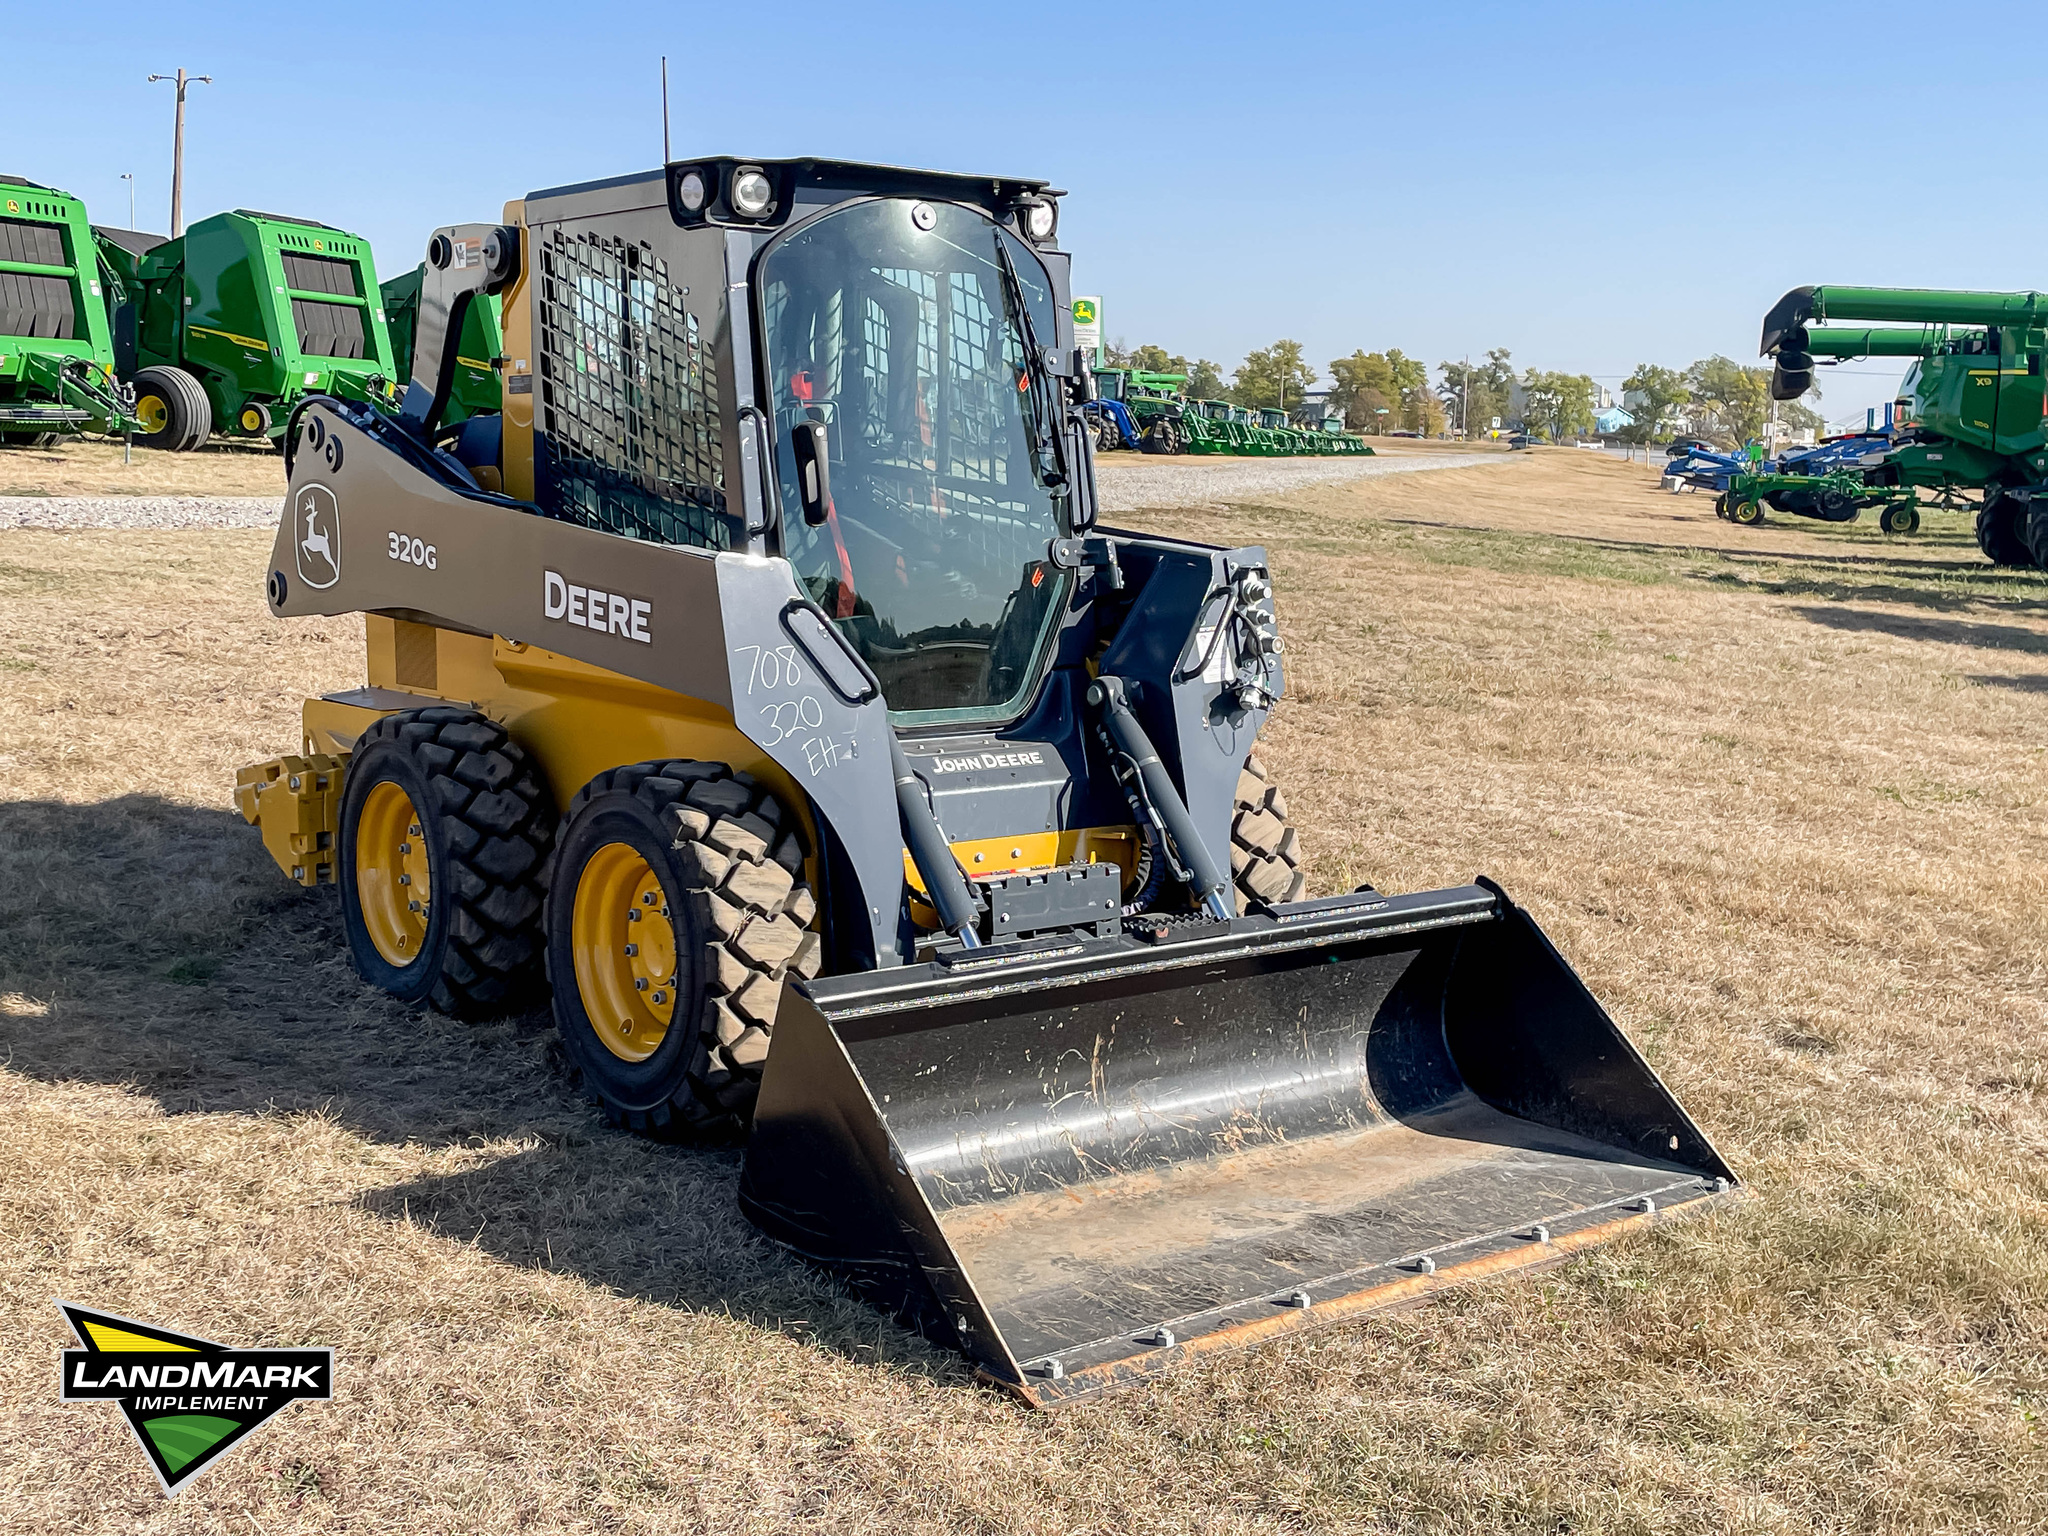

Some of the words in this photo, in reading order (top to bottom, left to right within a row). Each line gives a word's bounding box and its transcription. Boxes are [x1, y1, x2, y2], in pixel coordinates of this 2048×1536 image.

[1975, 377, 1993, 387] X9
[388, 531, 438, 571] 320G
[544, 570, 652, 644] DEERE
[734, 645, 801, 695] 708
[760, 696, 823, 746] 320
[932, 756, 982, 774] JOHN
[981, 752, 1044, 768] DEERE
